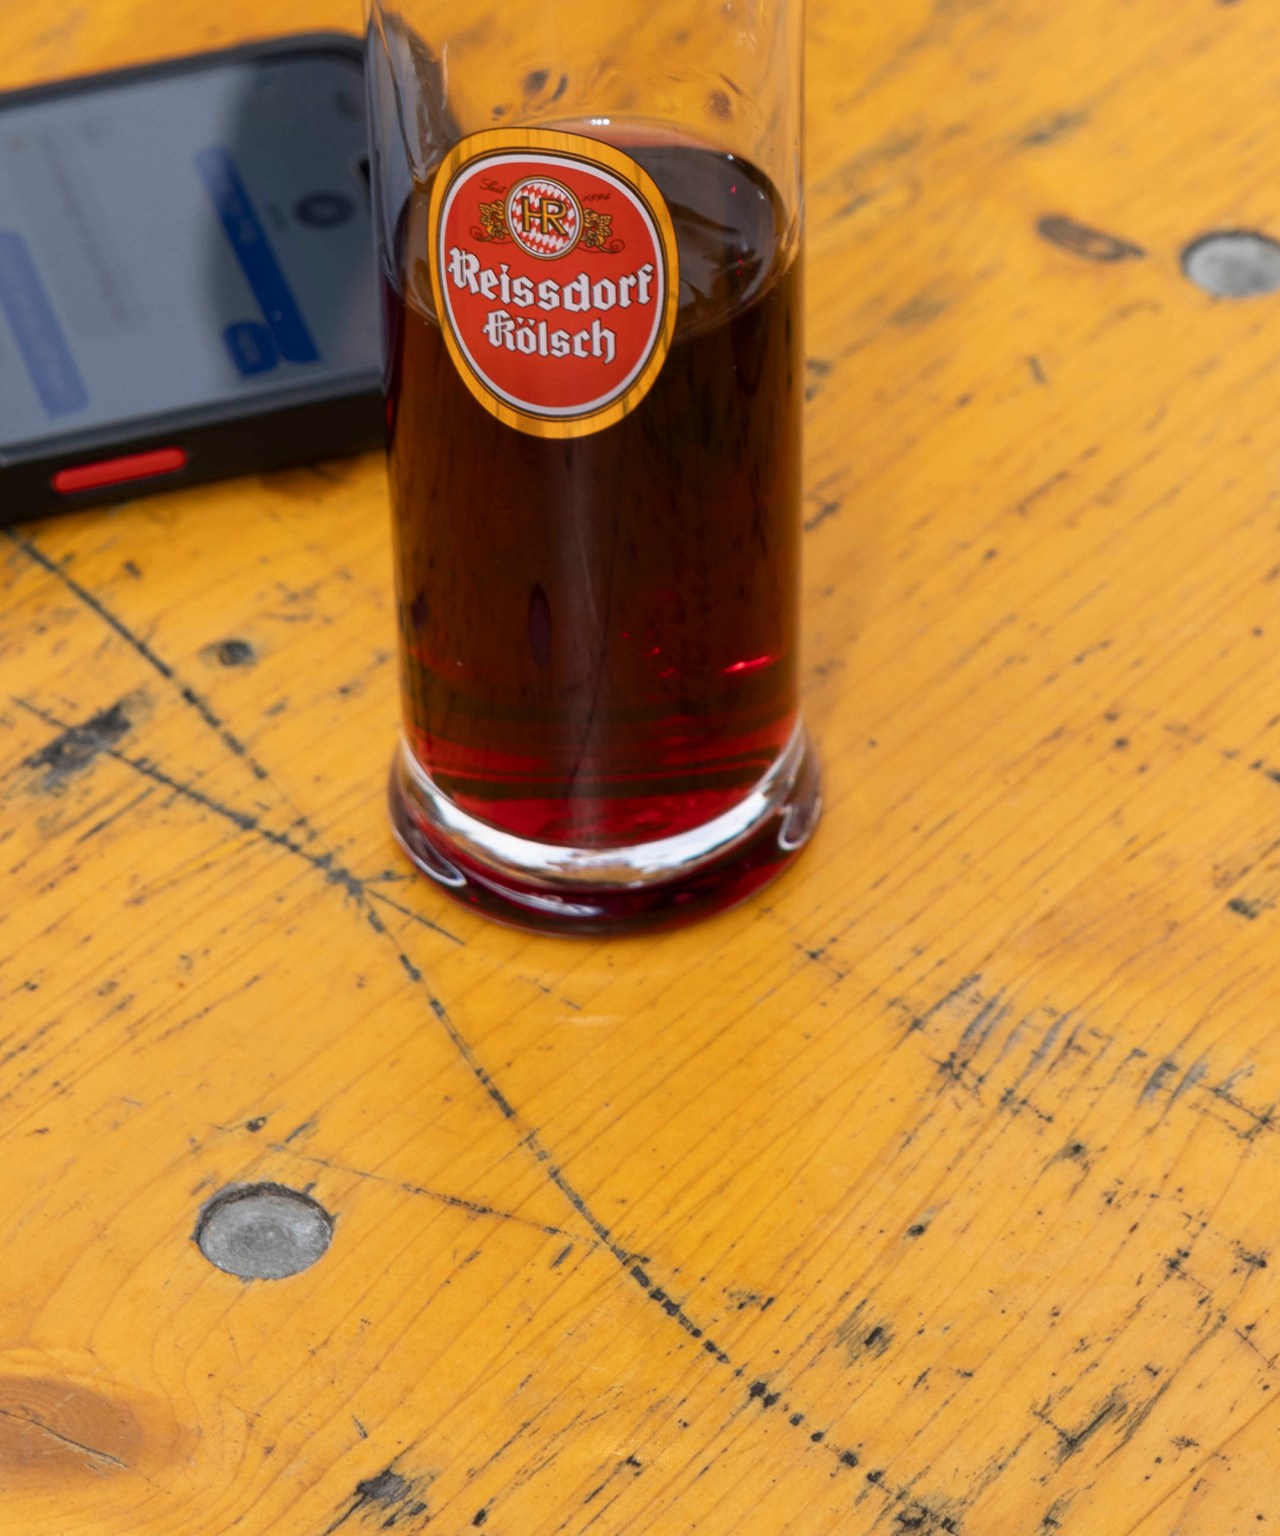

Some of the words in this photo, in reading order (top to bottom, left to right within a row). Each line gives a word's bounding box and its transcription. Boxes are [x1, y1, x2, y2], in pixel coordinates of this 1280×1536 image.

[479, 178, 507, 195] Seit
[521, 195, 569, 236] HR
[448, 247, 655, 313] Reissdorf
[484, 309, 617, 365] Kölsch
